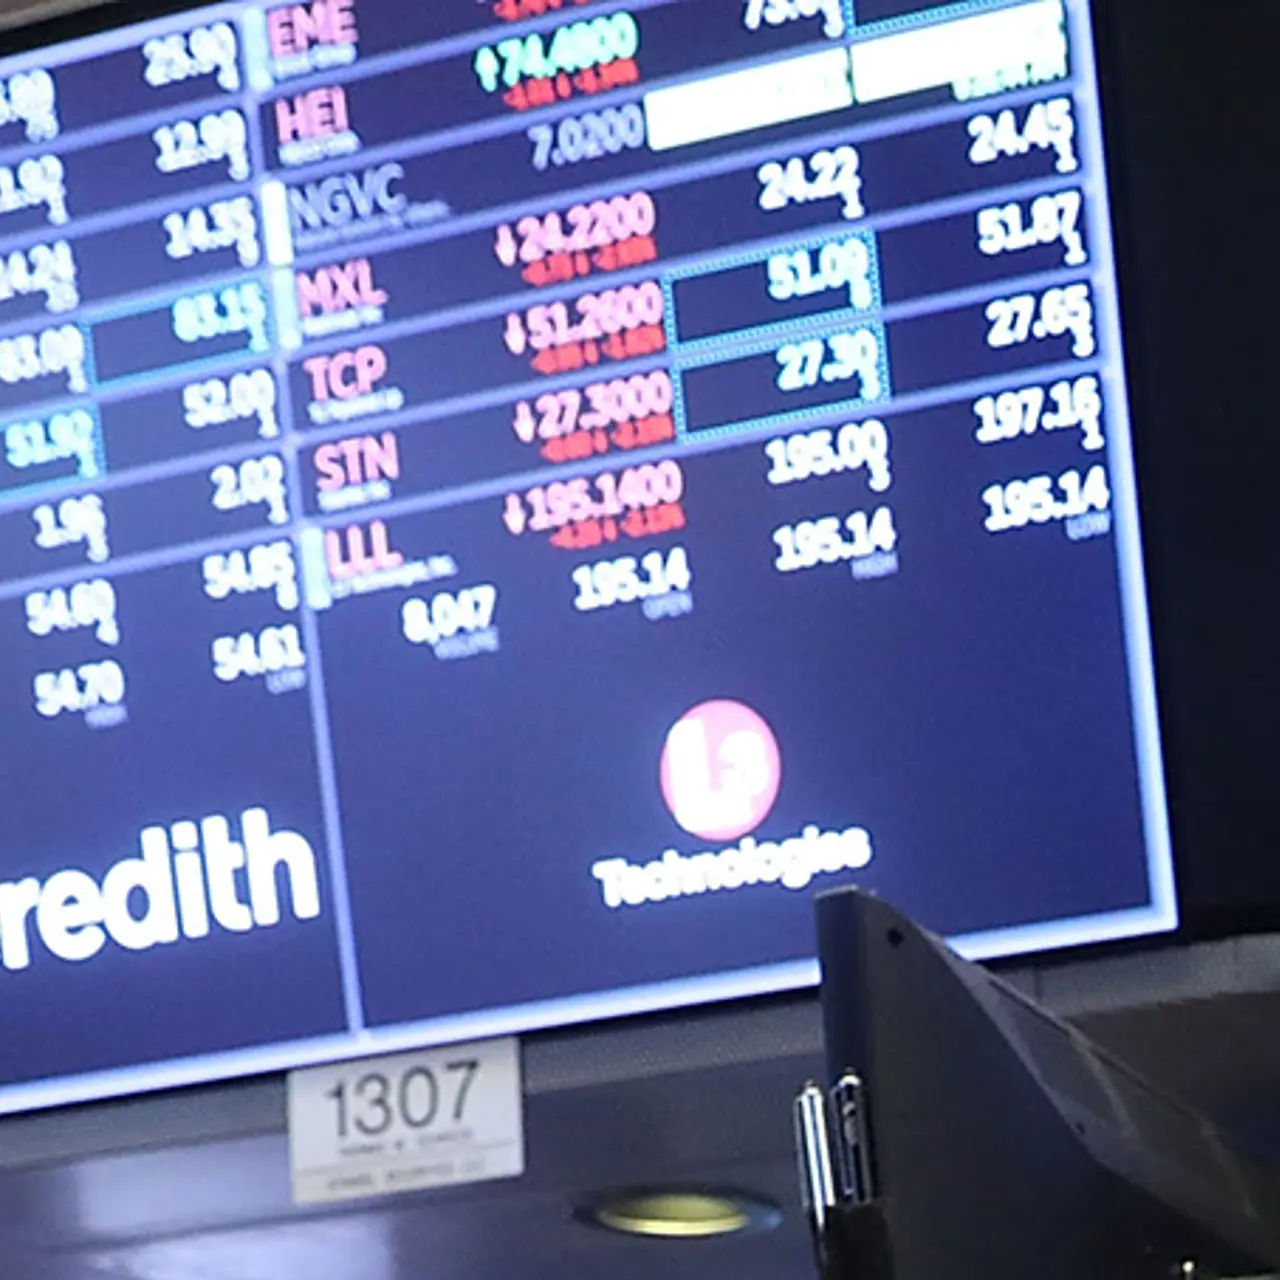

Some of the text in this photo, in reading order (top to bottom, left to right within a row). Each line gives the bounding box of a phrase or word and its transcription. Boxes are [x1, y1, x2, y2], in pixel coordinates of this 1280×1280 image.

[277, 87, 348, 142] HEI
[529, 104, 644, 169] 7.0200
[968, 99, 1073, 163] 24.45
[289, 163, 405, 230] NGVC
[759, 147, 858, 209] 24.22
[518, 192, 655, 261] 24.2200
[978, 192, 1080, 254] 51.87
[297, 260, 388, 316] MXL
[986, 285, 1090, 346] 27.65
[305, 345, 387, 402] TCP
[315, 433, 401, 492] STN
[982, 465, 1110, 531] 195.14
[326, 520, 404, 578] LLL
[772, 508, 896, 571] 195.14
[572, 547, 691, 610] 195.14
[592, 826, 872, 907] Technologies
[325, 1059, 479, 1137] 1307
